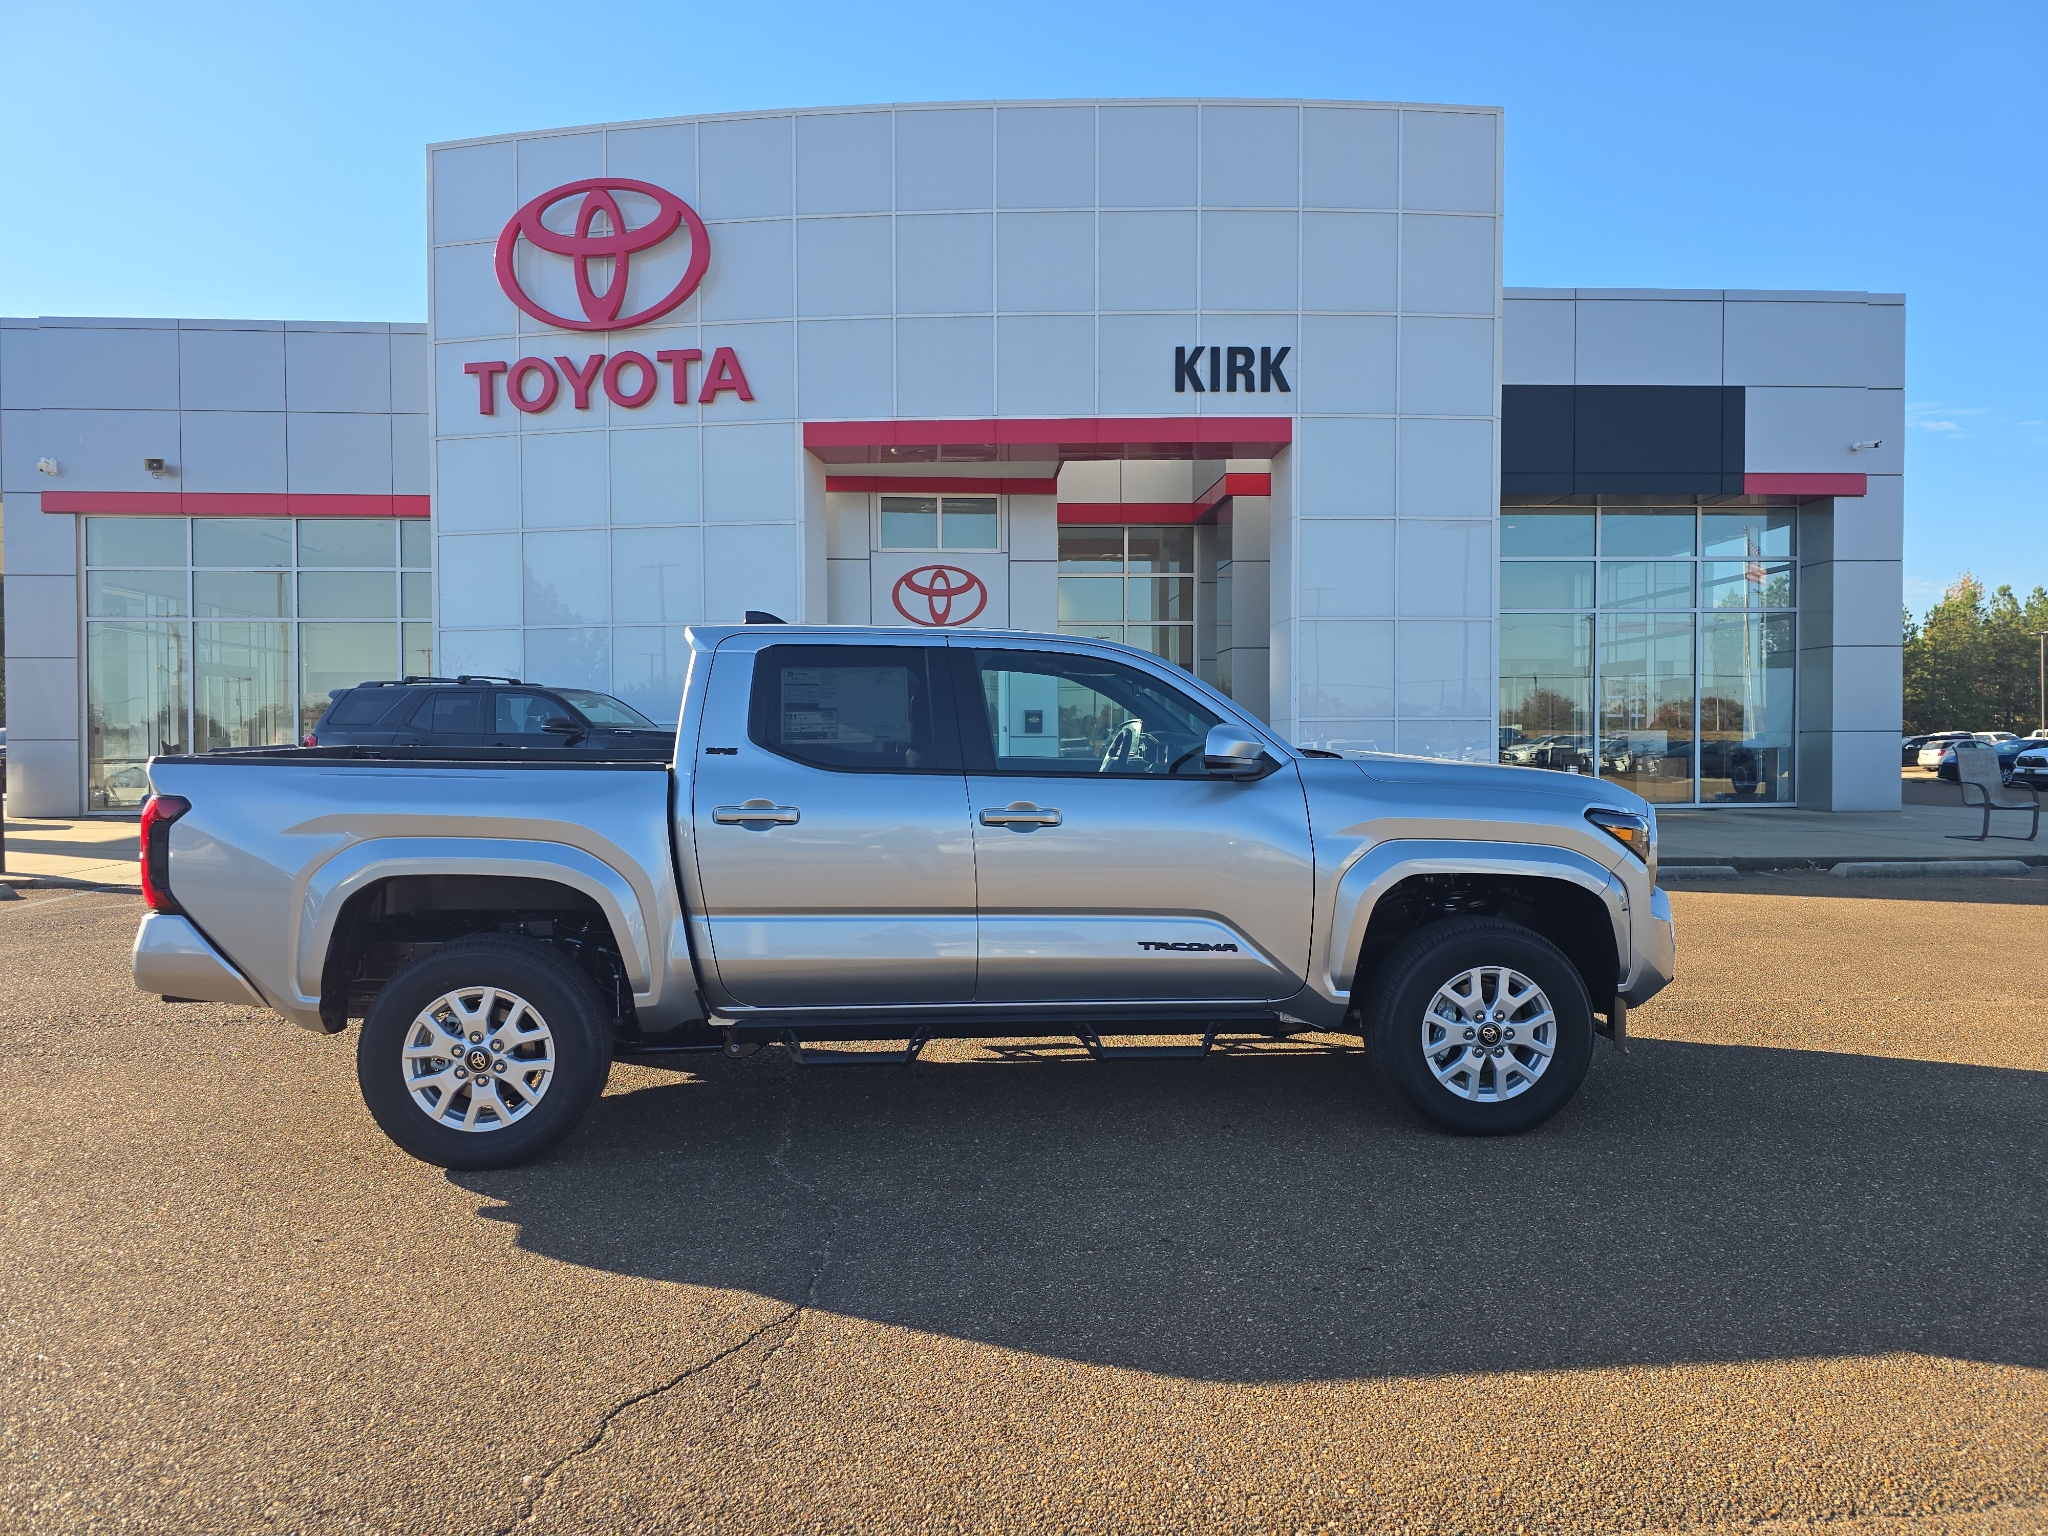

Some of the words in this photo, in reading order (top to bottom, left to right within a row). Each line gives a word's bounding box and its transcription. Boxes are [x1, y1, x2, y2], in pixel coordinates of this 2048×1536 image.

[463, 346, 756, 416] TOYOTA
[1175, 346, 1292, 393] KIRK
[1137, 941, 1239, 953] TACOMA
